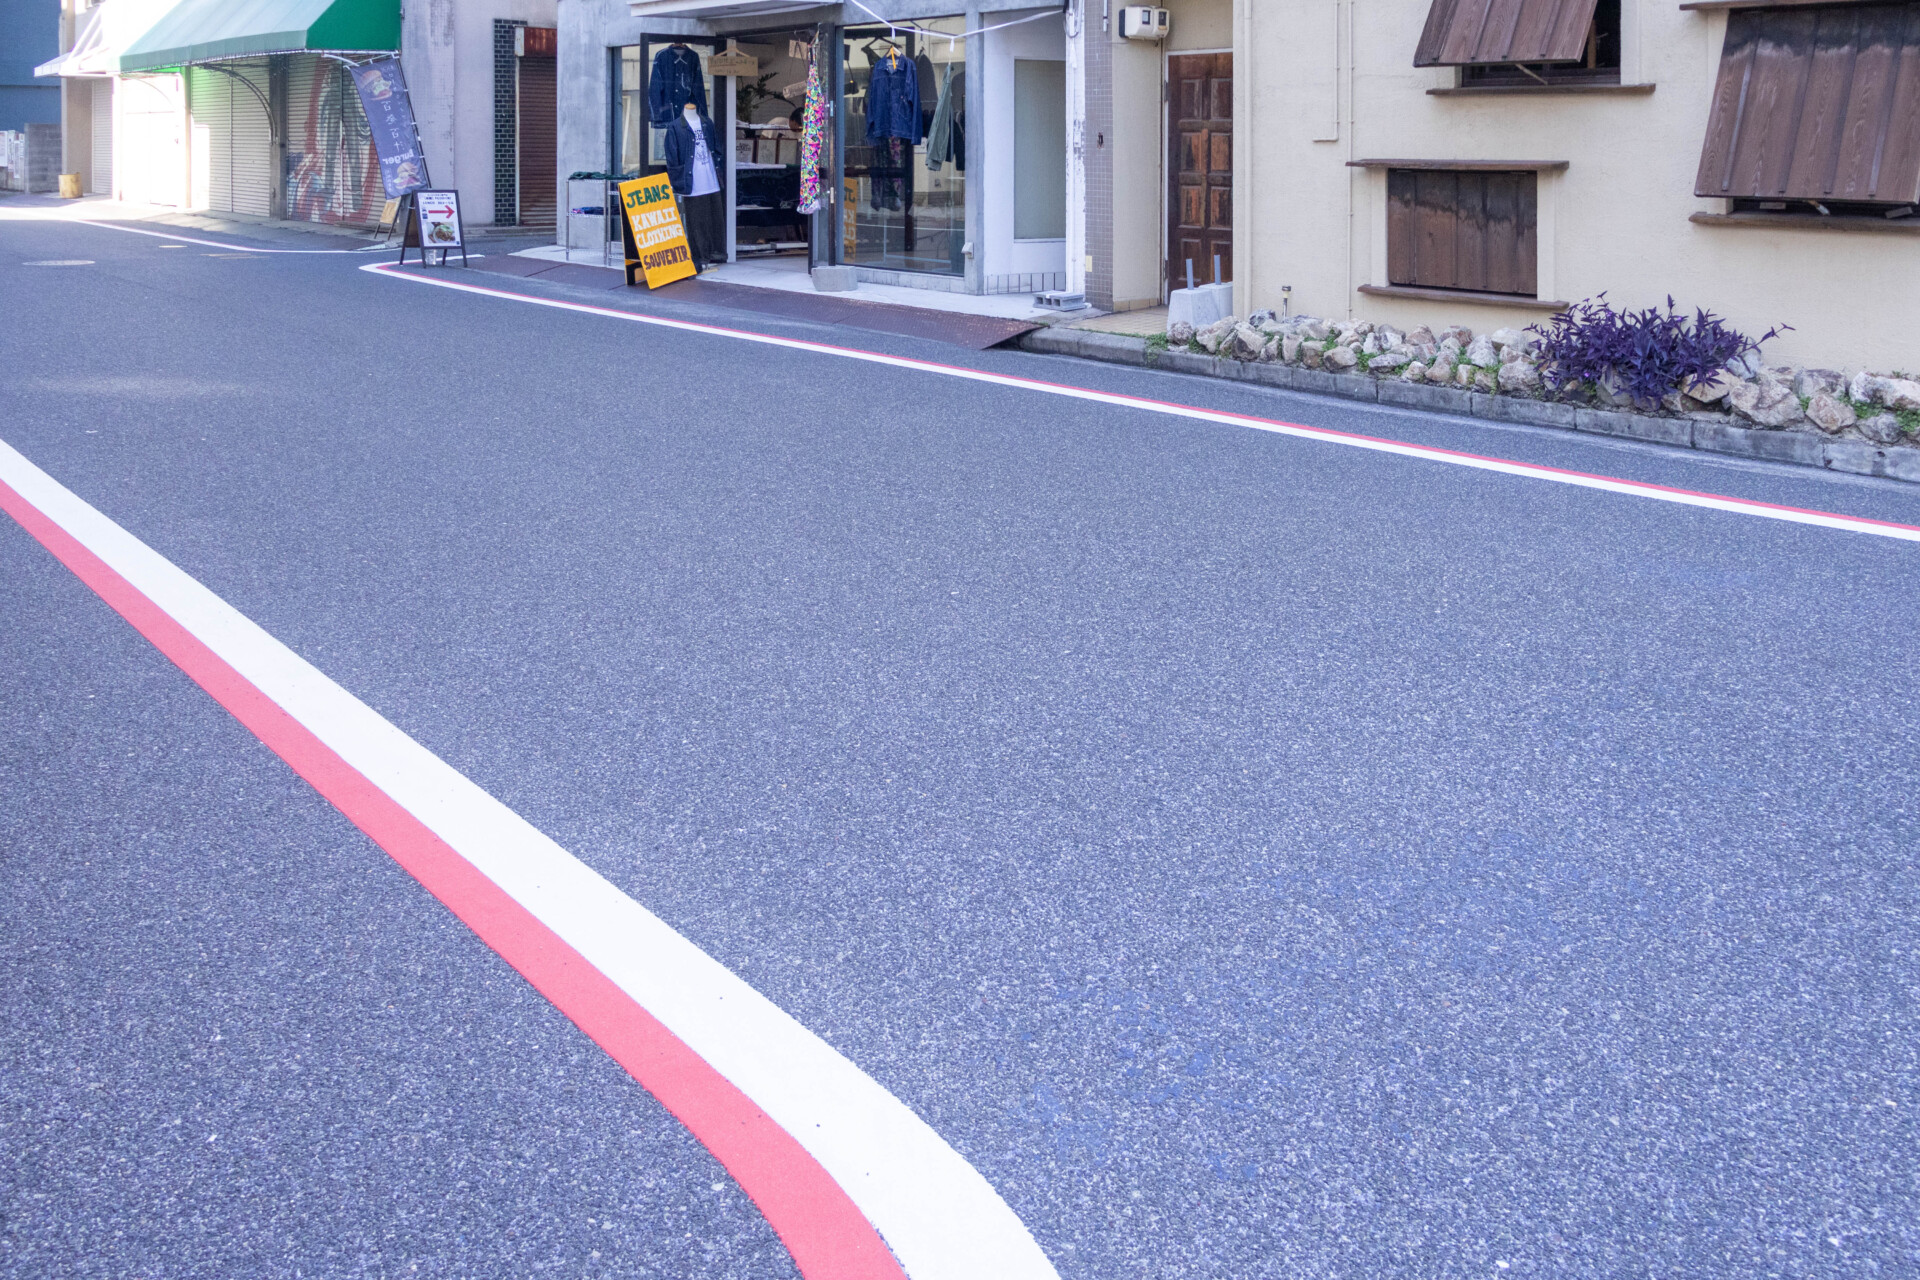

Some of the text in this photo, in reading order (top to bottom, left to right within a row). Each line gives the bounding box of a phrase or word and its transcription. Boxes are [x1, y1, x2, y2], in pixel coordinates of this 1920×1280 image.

[626, 184, 670, 208] JEANS
[631, 207, 677, 232] KAWAII
[636, 224, 683, 249] CLOTHING
[643, 245, 690, 270] SOUVENIR
